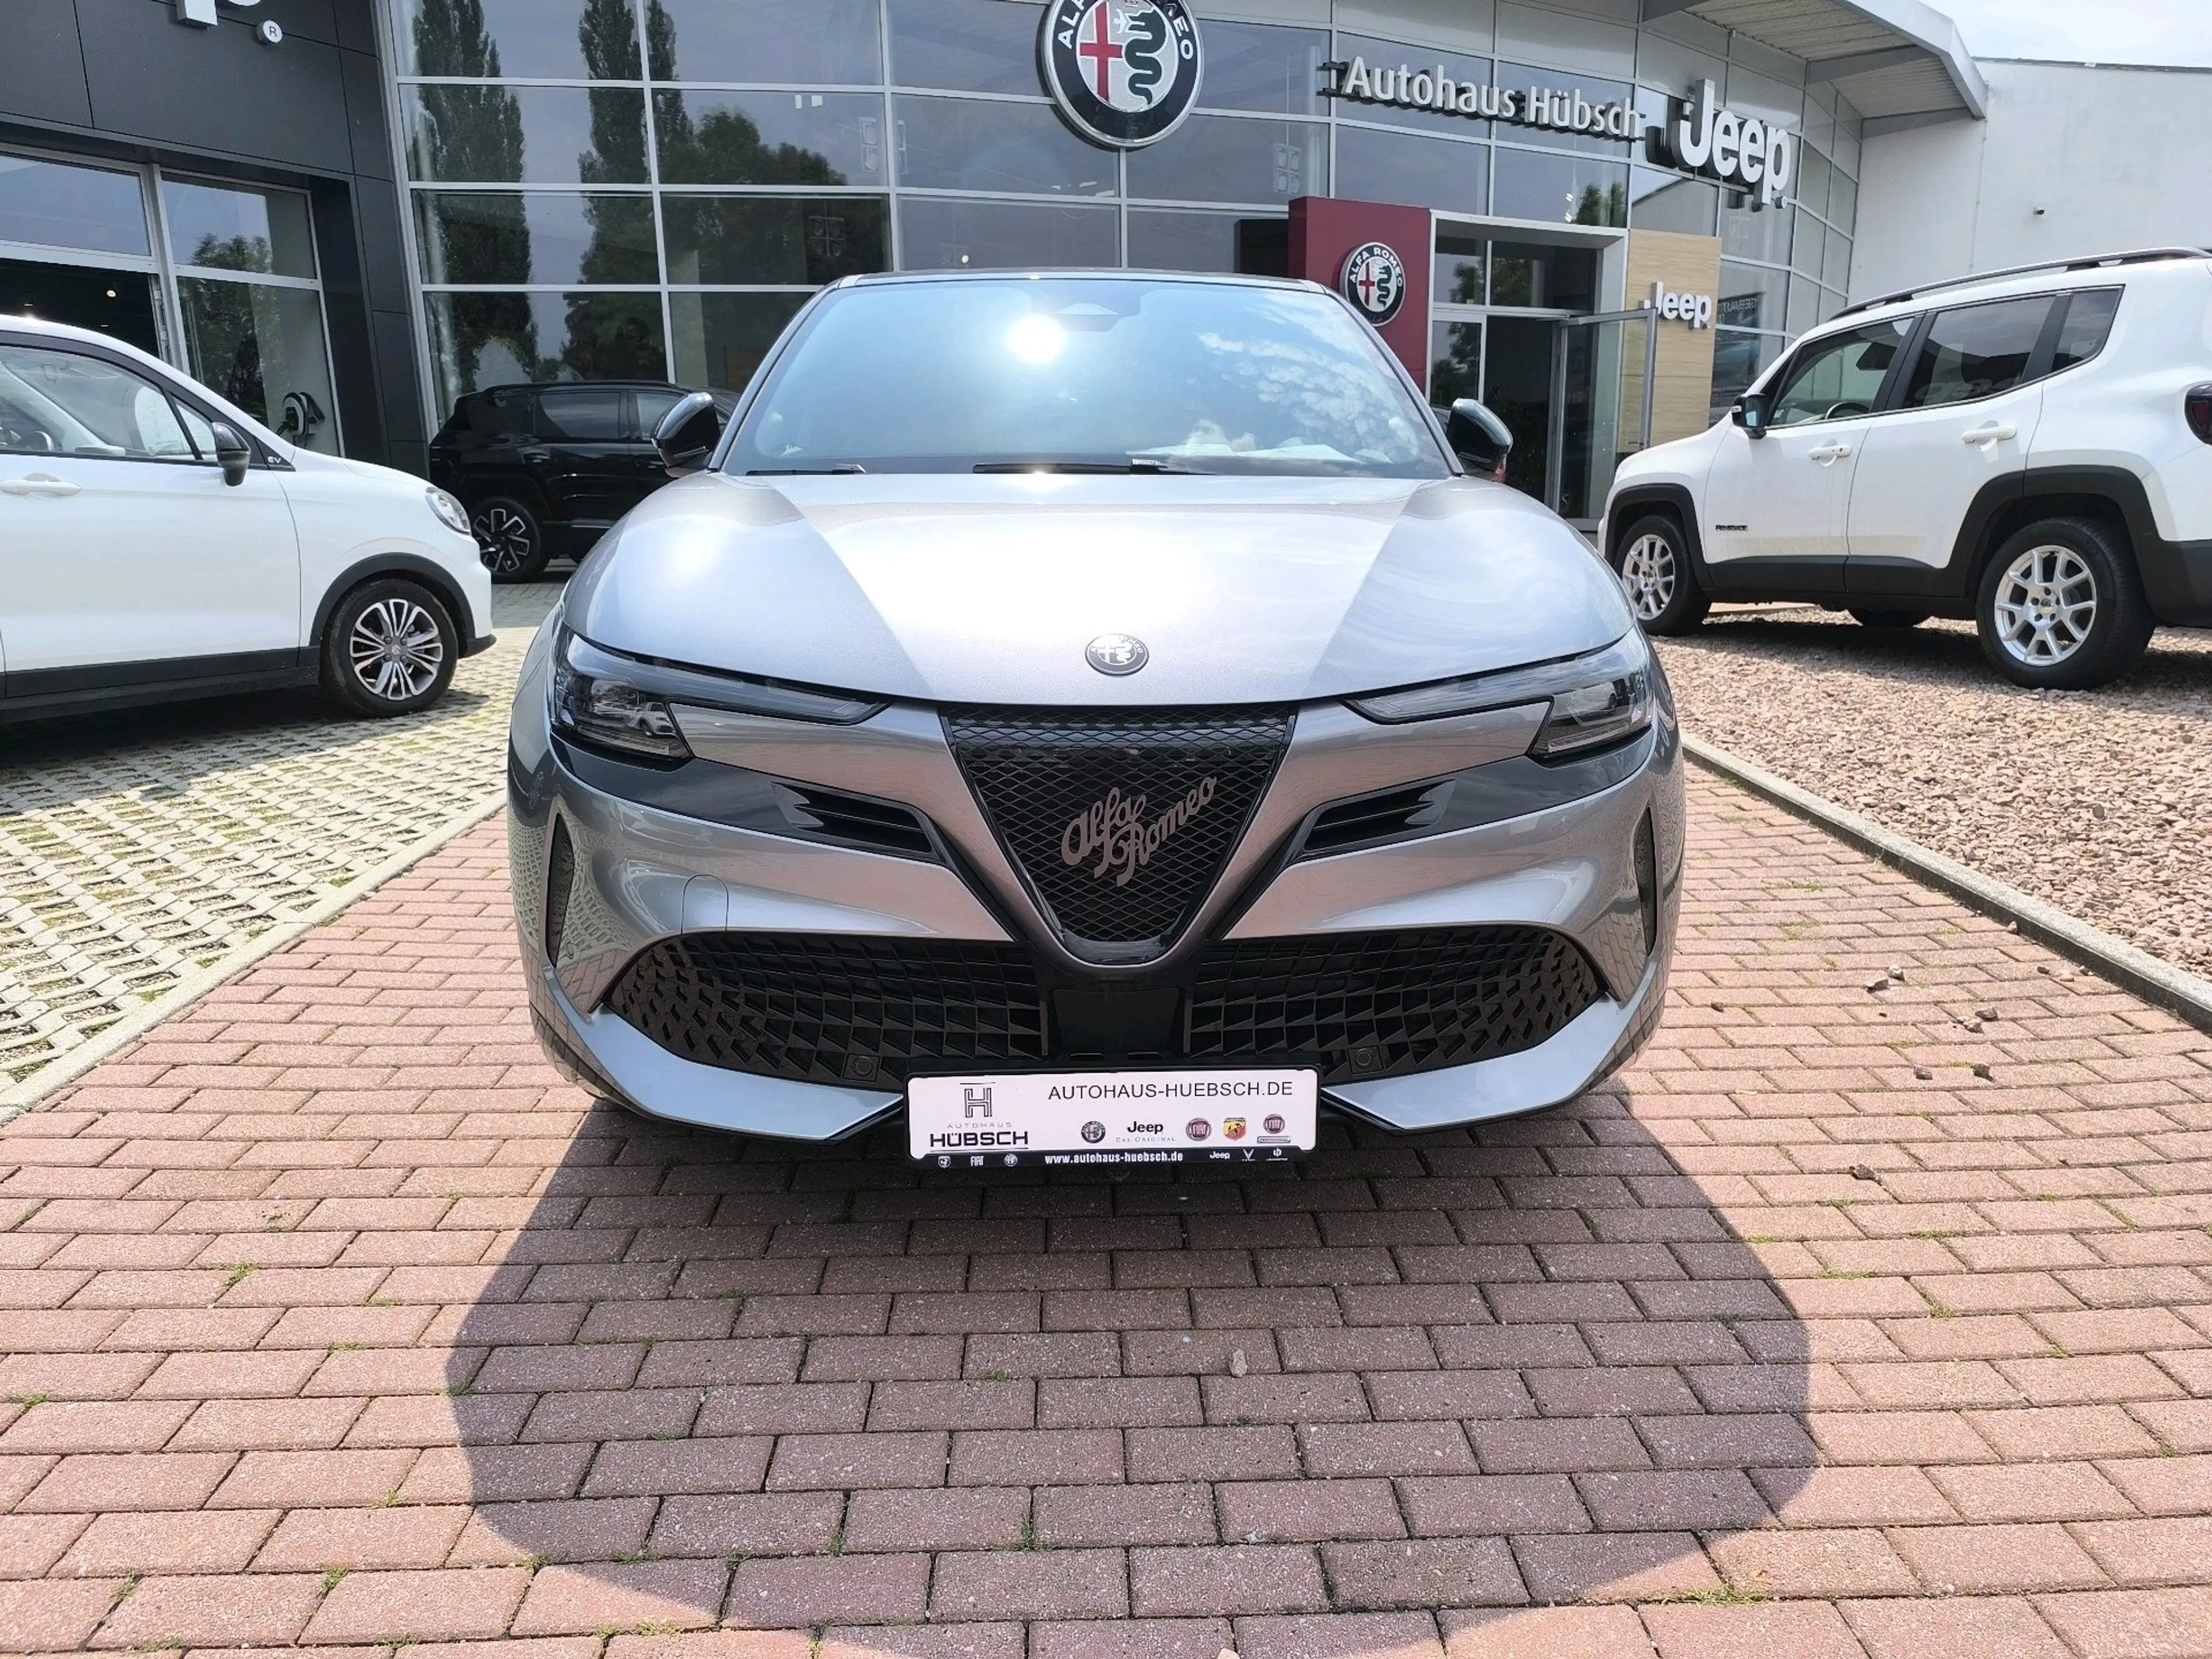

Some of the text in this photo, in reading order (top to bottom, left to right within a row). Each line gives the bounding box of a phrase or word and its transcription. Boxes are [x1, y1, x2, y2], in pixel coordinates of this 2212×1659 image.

[1344, 56, 1640, 137] Autohaus Hübsch
[1679, 78, 1791, 205] Jeep
[1349, 247, 1403, 287] ALFA ROMEO
[1048, 1081, 1293, 1100] AUTOHAUS-HUEBSCH.DE
[946, 1122, 1012, 1130] AUTOHAUS
[1127, 1120, 1164, 1135] Jeep
[930, 1131, 1029, 1147] HÜBSCH
[1044, 1151, 1183, 1164] www.autohaus-huebsch.de
